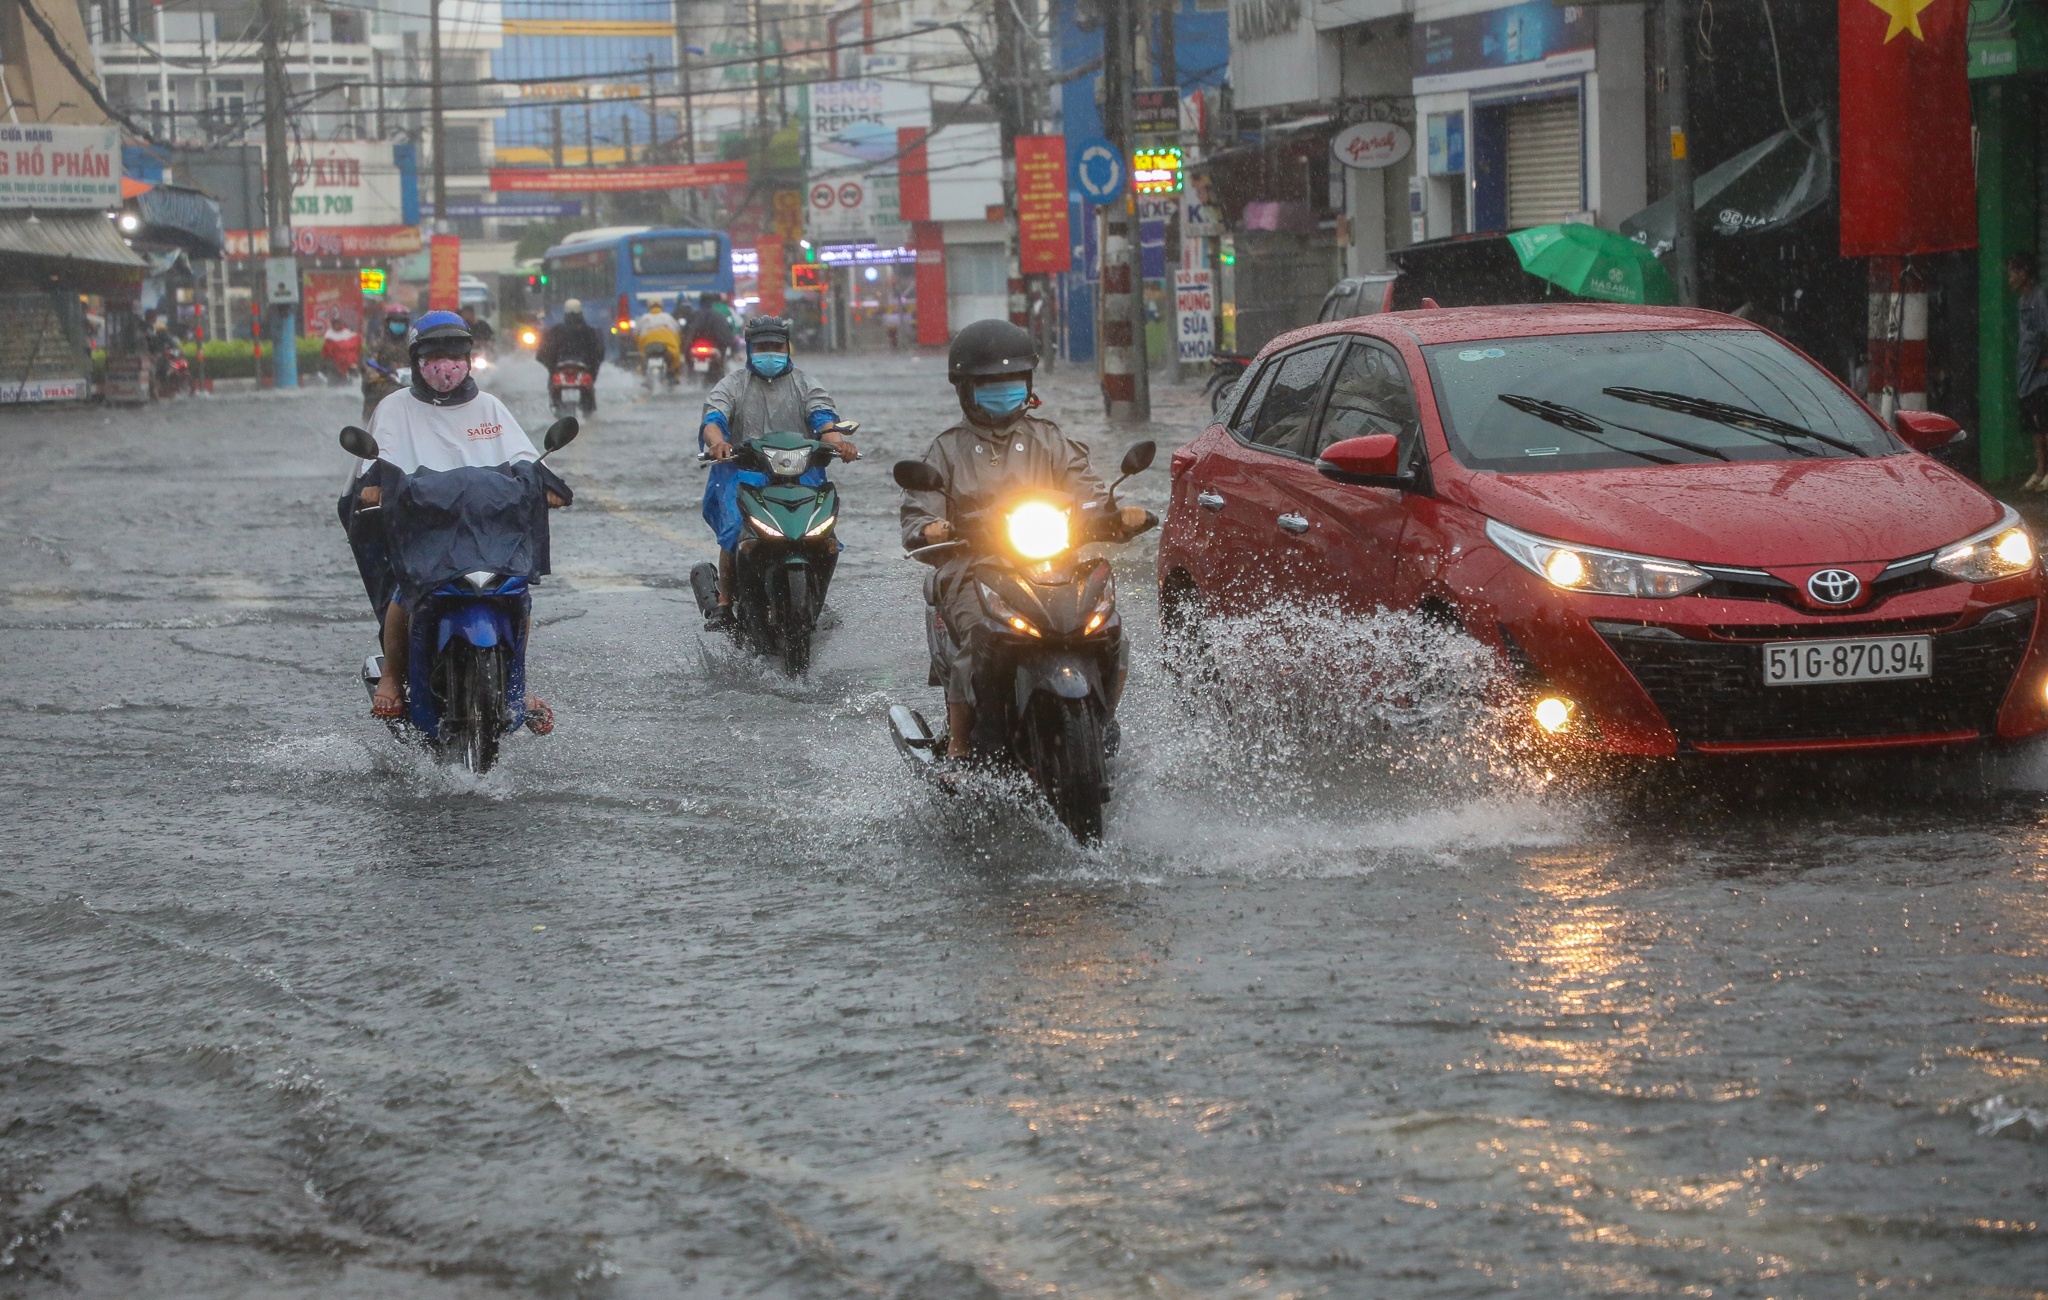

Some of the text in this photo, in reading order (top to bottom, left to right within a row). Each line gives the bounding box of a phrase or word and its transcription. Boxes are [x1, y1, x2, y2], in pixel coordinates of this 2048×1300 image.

[315, 149, 360, 187] KÍNH
[324, 195, 353, 214] PON
[1591, 278, 1629, 294] HASAKI
[1770, 641, 1925, 680] 51G-870.94
